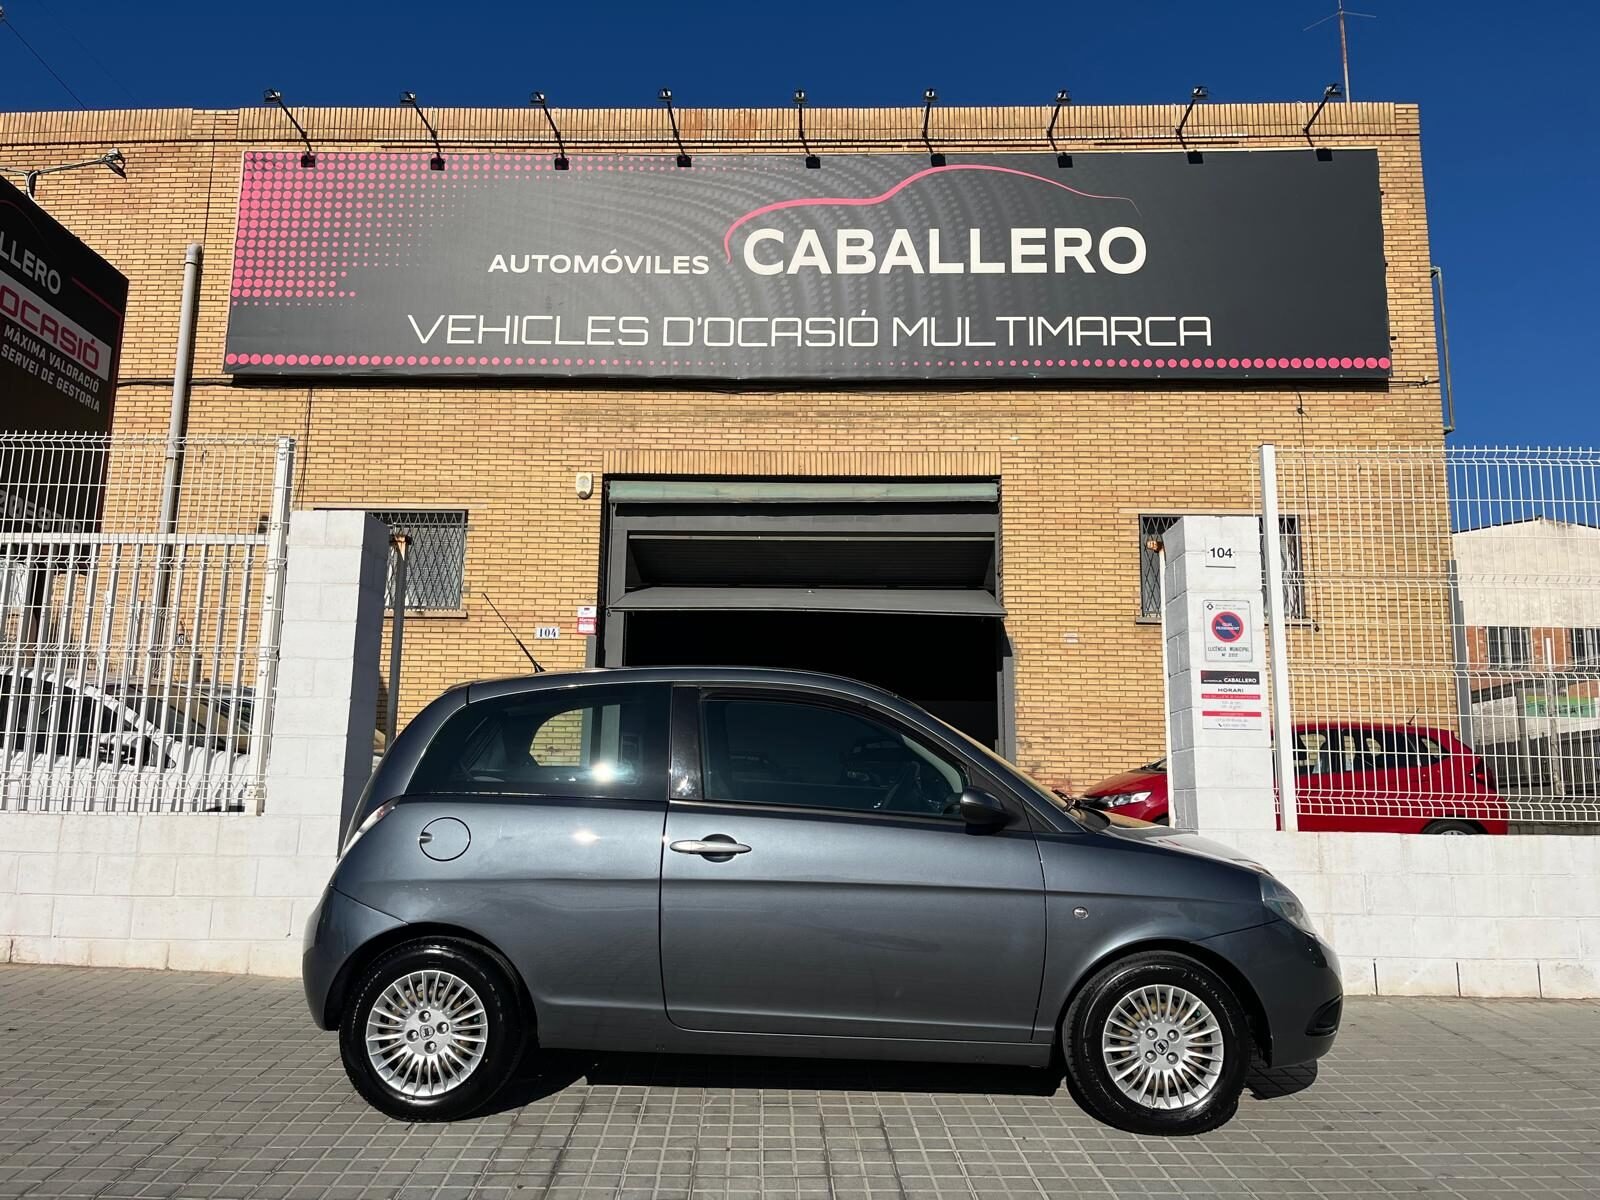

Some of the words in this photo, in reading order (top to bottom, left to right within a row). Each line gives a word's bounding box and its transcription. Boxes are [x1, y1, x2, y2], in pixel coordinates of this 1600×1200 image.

[488, 249, 710, 274] AUTOMÓVILES
[743, 226, 1147, 276] CABALLERO
[0, 285, 100, 370] OCASIÓ
[407, 314, 649, 346] VEHICLES
[662, 309, 879, 347] D'OCASIÓ
[892, 316, 1212, 347] MULTIMARCA
[1, 344, 39, 376] SERVEI
[41, 368, 55, 385] DE
[56, 377, 100, 413] GESTORIA
[4, 324, 46, 360] MÀXIMA
[49, 352, 99, 393] VALORACIÓ
[1209, 547, 1233, 559] 104
[539, 628, 557, 638] 104
